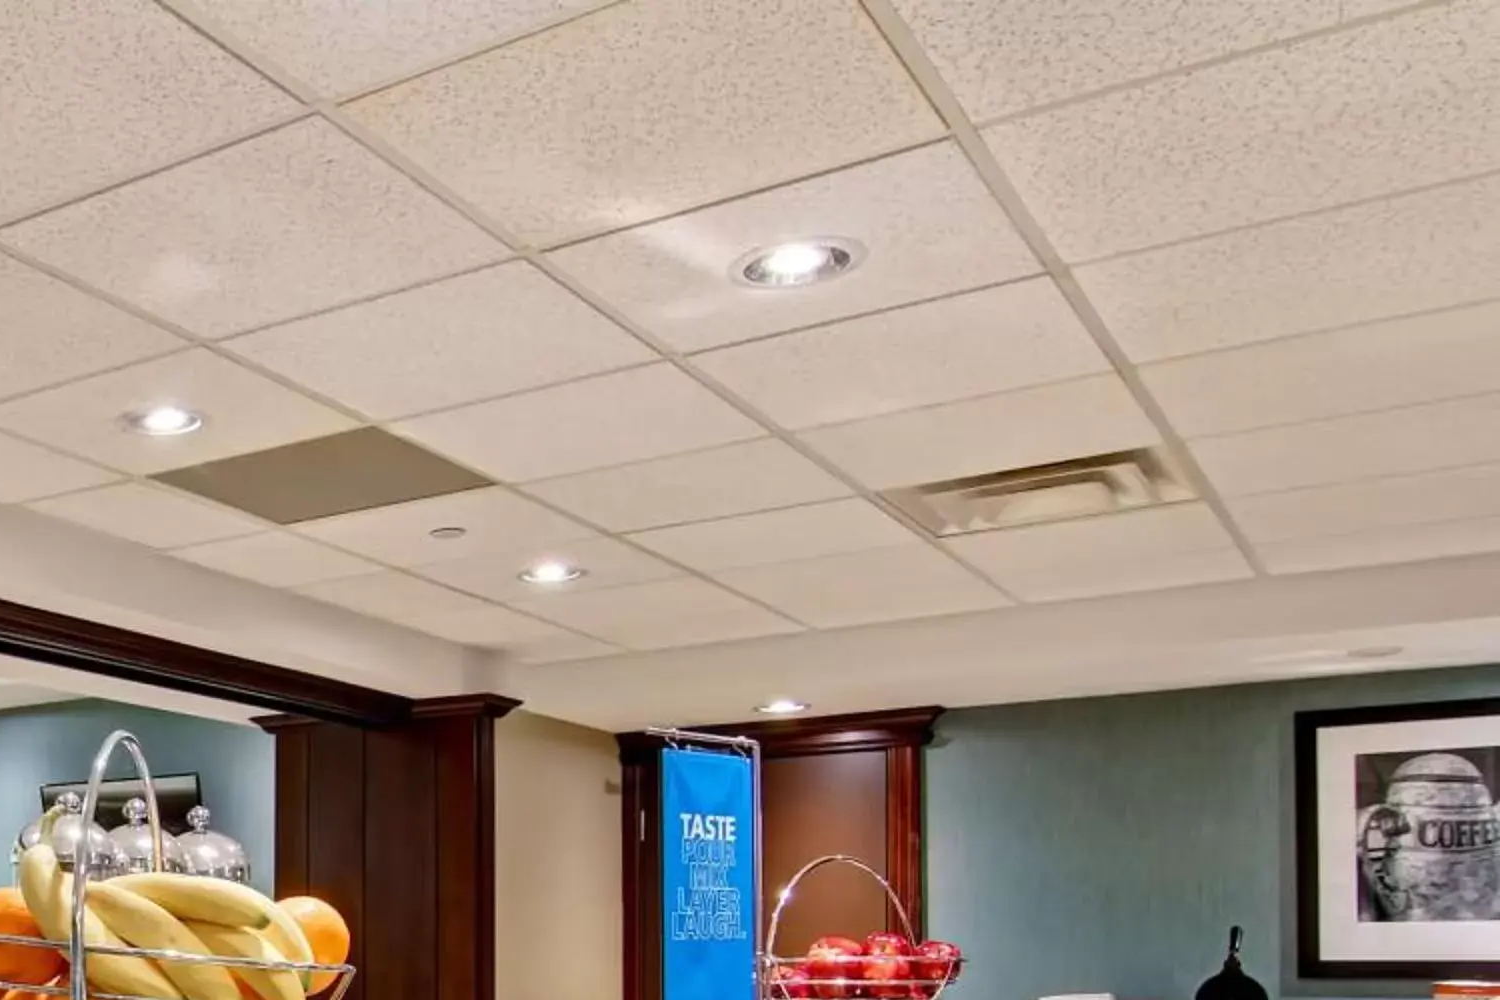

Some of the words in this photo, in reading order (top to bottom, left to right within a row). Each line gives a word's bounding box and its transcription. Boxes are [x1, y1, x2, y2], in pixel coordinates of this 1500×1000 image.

[680, 813, 737, 841] TASTE
[681, 838, 737, 865] POUR
[689, 861, 730, 890] MIX
[677, 887, 741, 914] LAYER
[671, 912, 747, 940] LAUGH.
